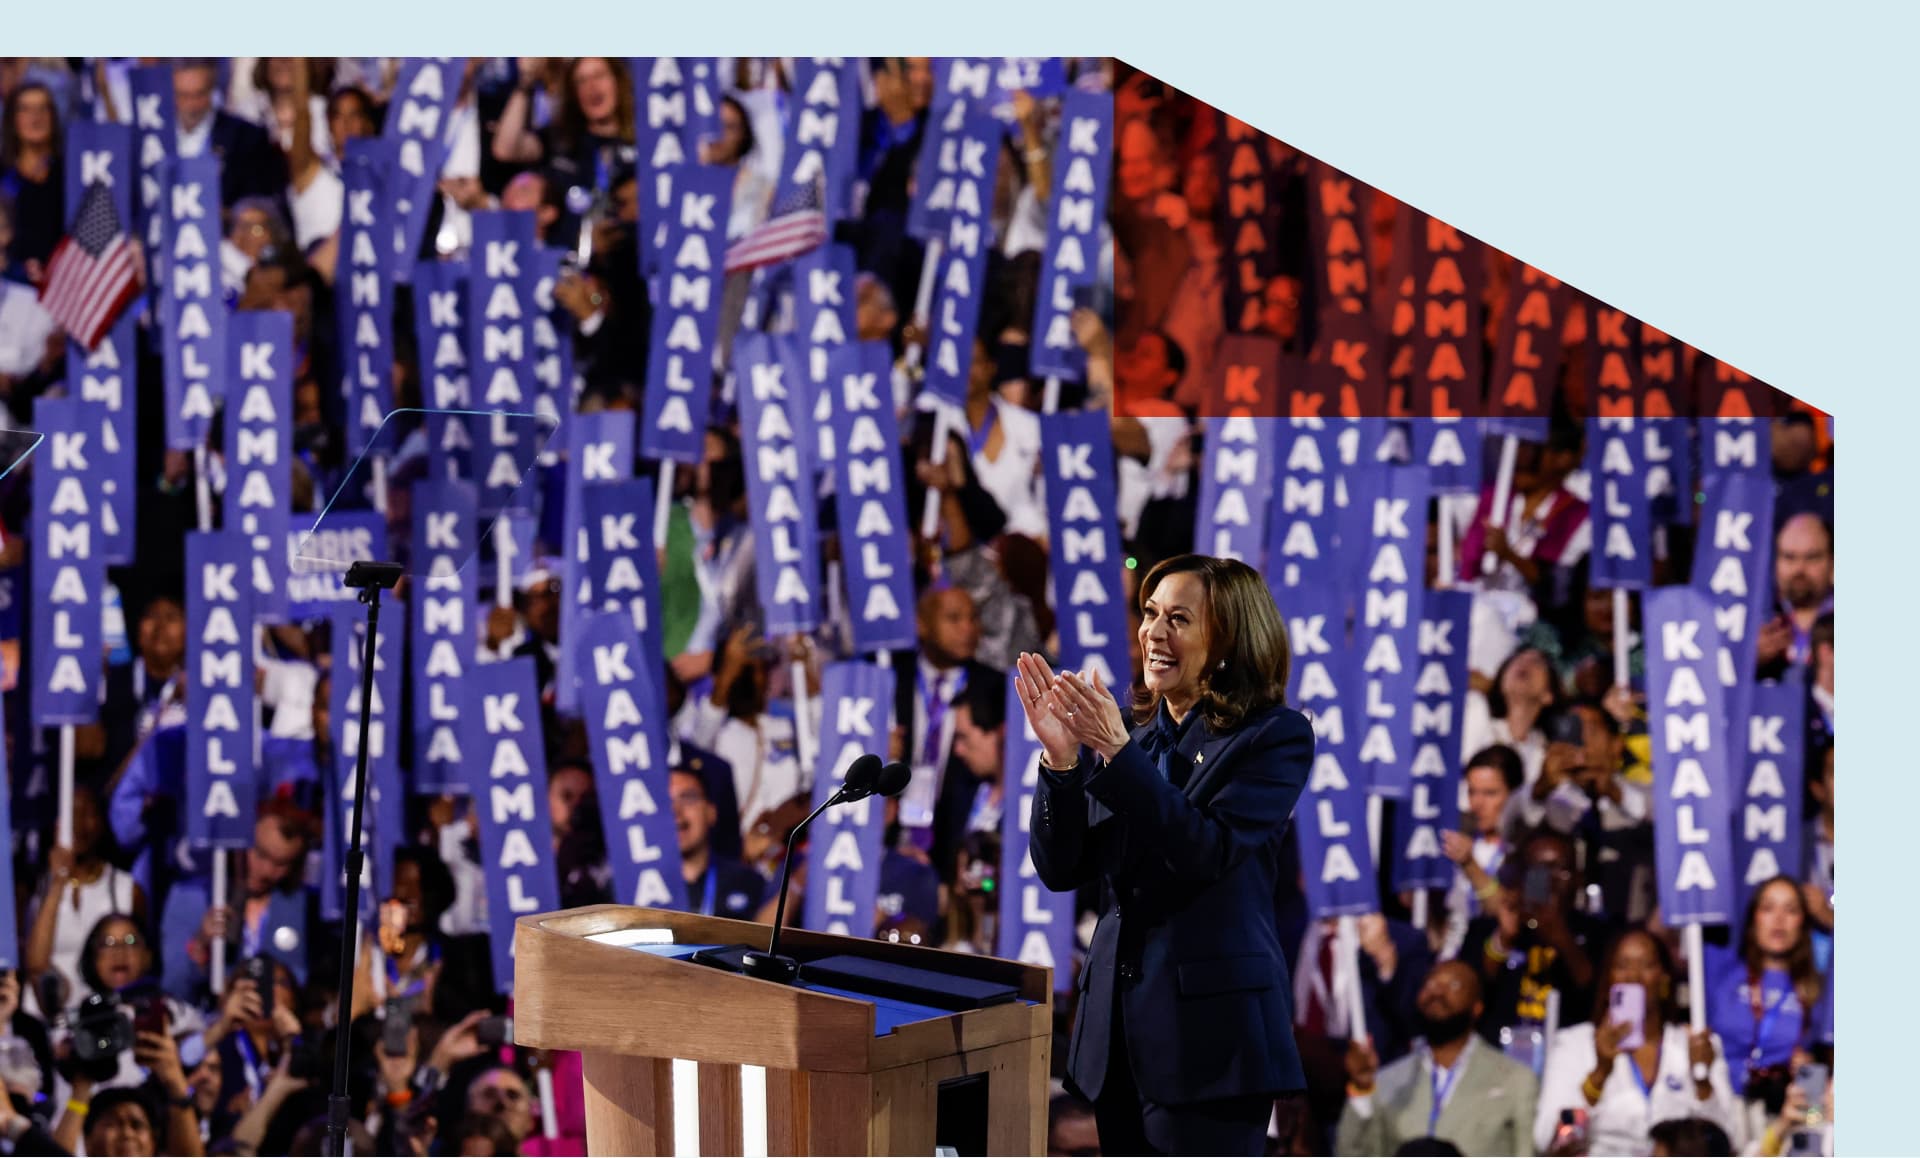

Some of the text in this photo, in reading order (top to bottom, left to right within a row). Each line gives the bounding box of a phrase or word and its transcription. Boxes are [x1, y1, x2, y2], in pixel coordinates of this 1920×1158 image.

[172, 182, 212, 421] KAMALA
[349, 189, 384, 428] KAMALA
[657, 191, 716, 434] KAMALA
[936, 137, 987, 378] KAMALA
[1045, 116, 1099, 348] KAMALA
[484, 240, 524, 488] KAMALA
[751, 363, 811, 605] KAMALA
[1213, 366, 1262, 561] KAMAL
[1596, 309, 1638, 562] KAMALA
[49, 431, 91, 693] KAMALA
[843, 372, 900, 622] KAMALA
[201, 563, 242, 817] KAMALA
[423, 511, 464, 764] KAMALA
[1289, 614, 1361, 884] KAMALA
[1357, 498, 1410, 765] KAMALA
[1406, 619, 1454, 860] KAMALA
[1662, 620, 1718, 892] KAMALA
[483, 693, 540, 957] KAMAL
[593, 642, 673, 907] KAMALA
[1744, 715, 1788, 886] KAMA
